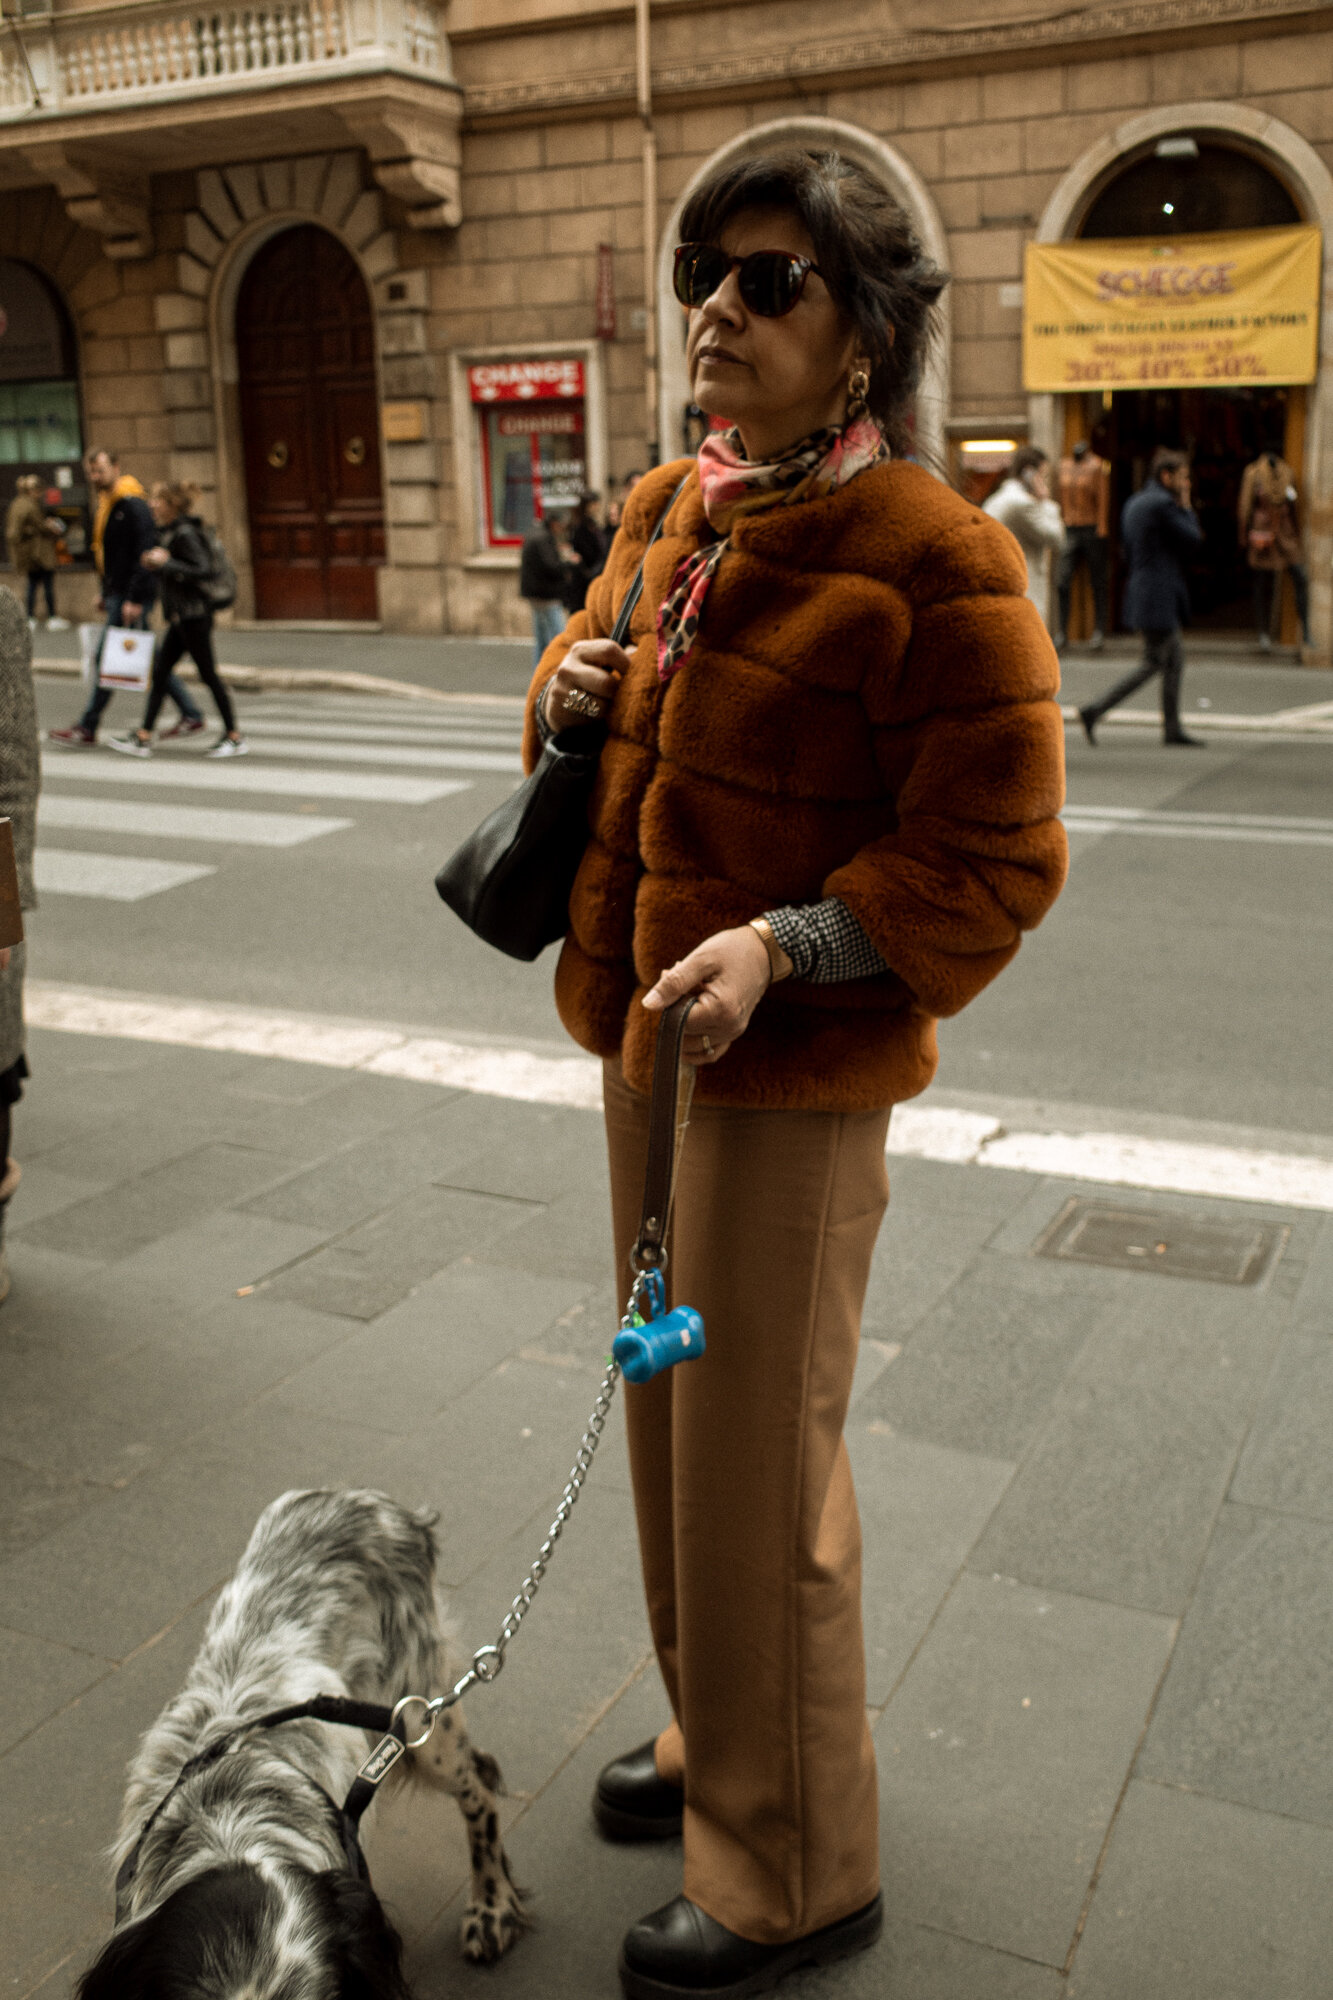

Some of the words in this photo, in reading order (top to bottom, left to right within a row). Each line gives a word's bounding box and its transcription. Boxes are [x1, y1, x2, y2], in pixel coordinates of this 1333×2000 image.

[1096, 262, 1237, 301] SCHEGGE
[472, 362, 577, 386] CHANGE
[1204, 355, 1268, 379] 50%
